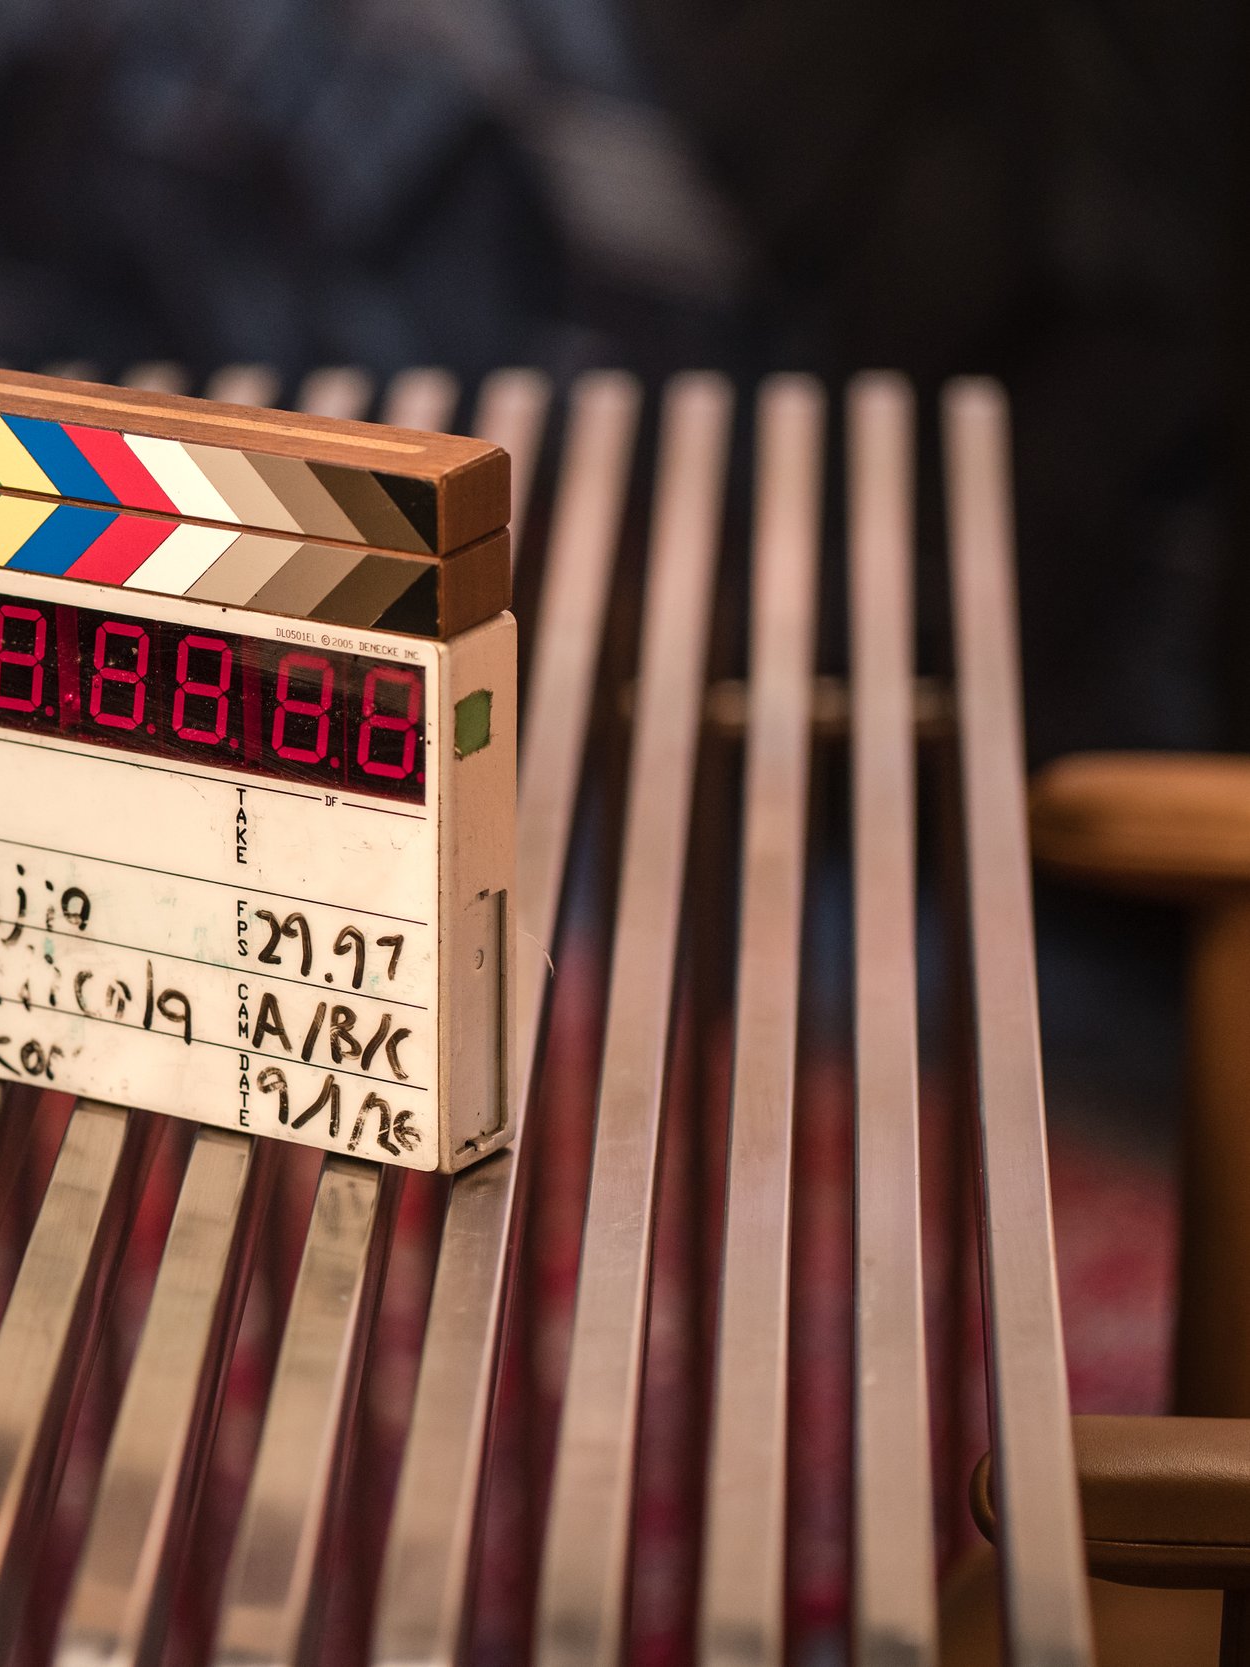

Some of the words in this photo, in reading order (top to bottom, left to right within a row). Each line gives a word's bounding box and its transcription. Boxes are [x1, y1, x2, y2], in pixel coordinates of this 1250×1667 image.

[358, 641, 399, 658] DENECKE
[235, 788, 248, 864] TAKE
[324, 795, 339, 808] DF
[237, 900, 249, 957] FPS
[253, 910, 406, 990] 29.97
[237, 984, 249, 1039] CAM
[252, 992, 413, 1081] A/B/C
[238, 1054, 250, 1127] DATE
